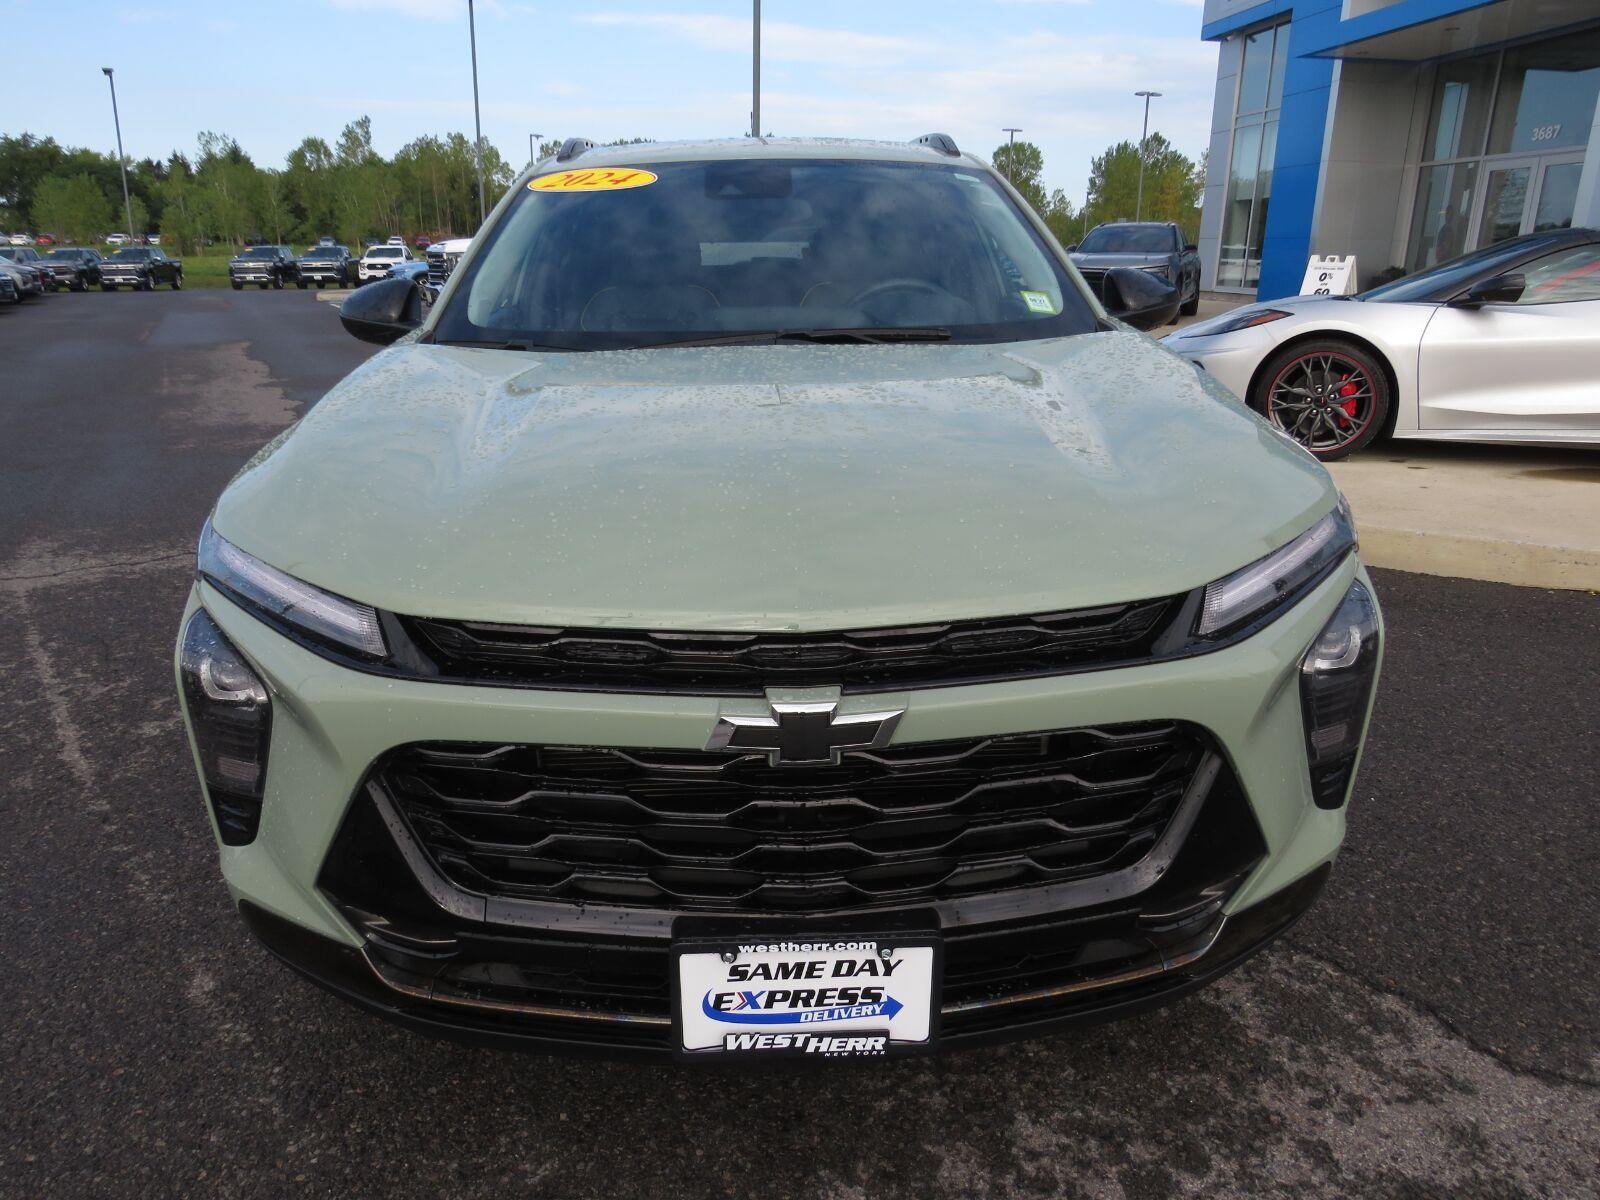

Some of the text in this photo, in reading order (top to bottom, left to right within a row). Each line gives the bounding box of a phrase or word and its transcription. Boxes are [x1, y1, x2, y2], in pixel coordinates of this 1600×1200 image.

[1531, 124, 1561, 141] 3687
[541, 172, 639, 188] 2024
[738, 941, 876, 953] westherr.com
[727, 959, 904, 982] SAME DAY
[713, 987, 884, 1011] EXPRESS
[800, 1004, 884, 1023] DELIVERY
